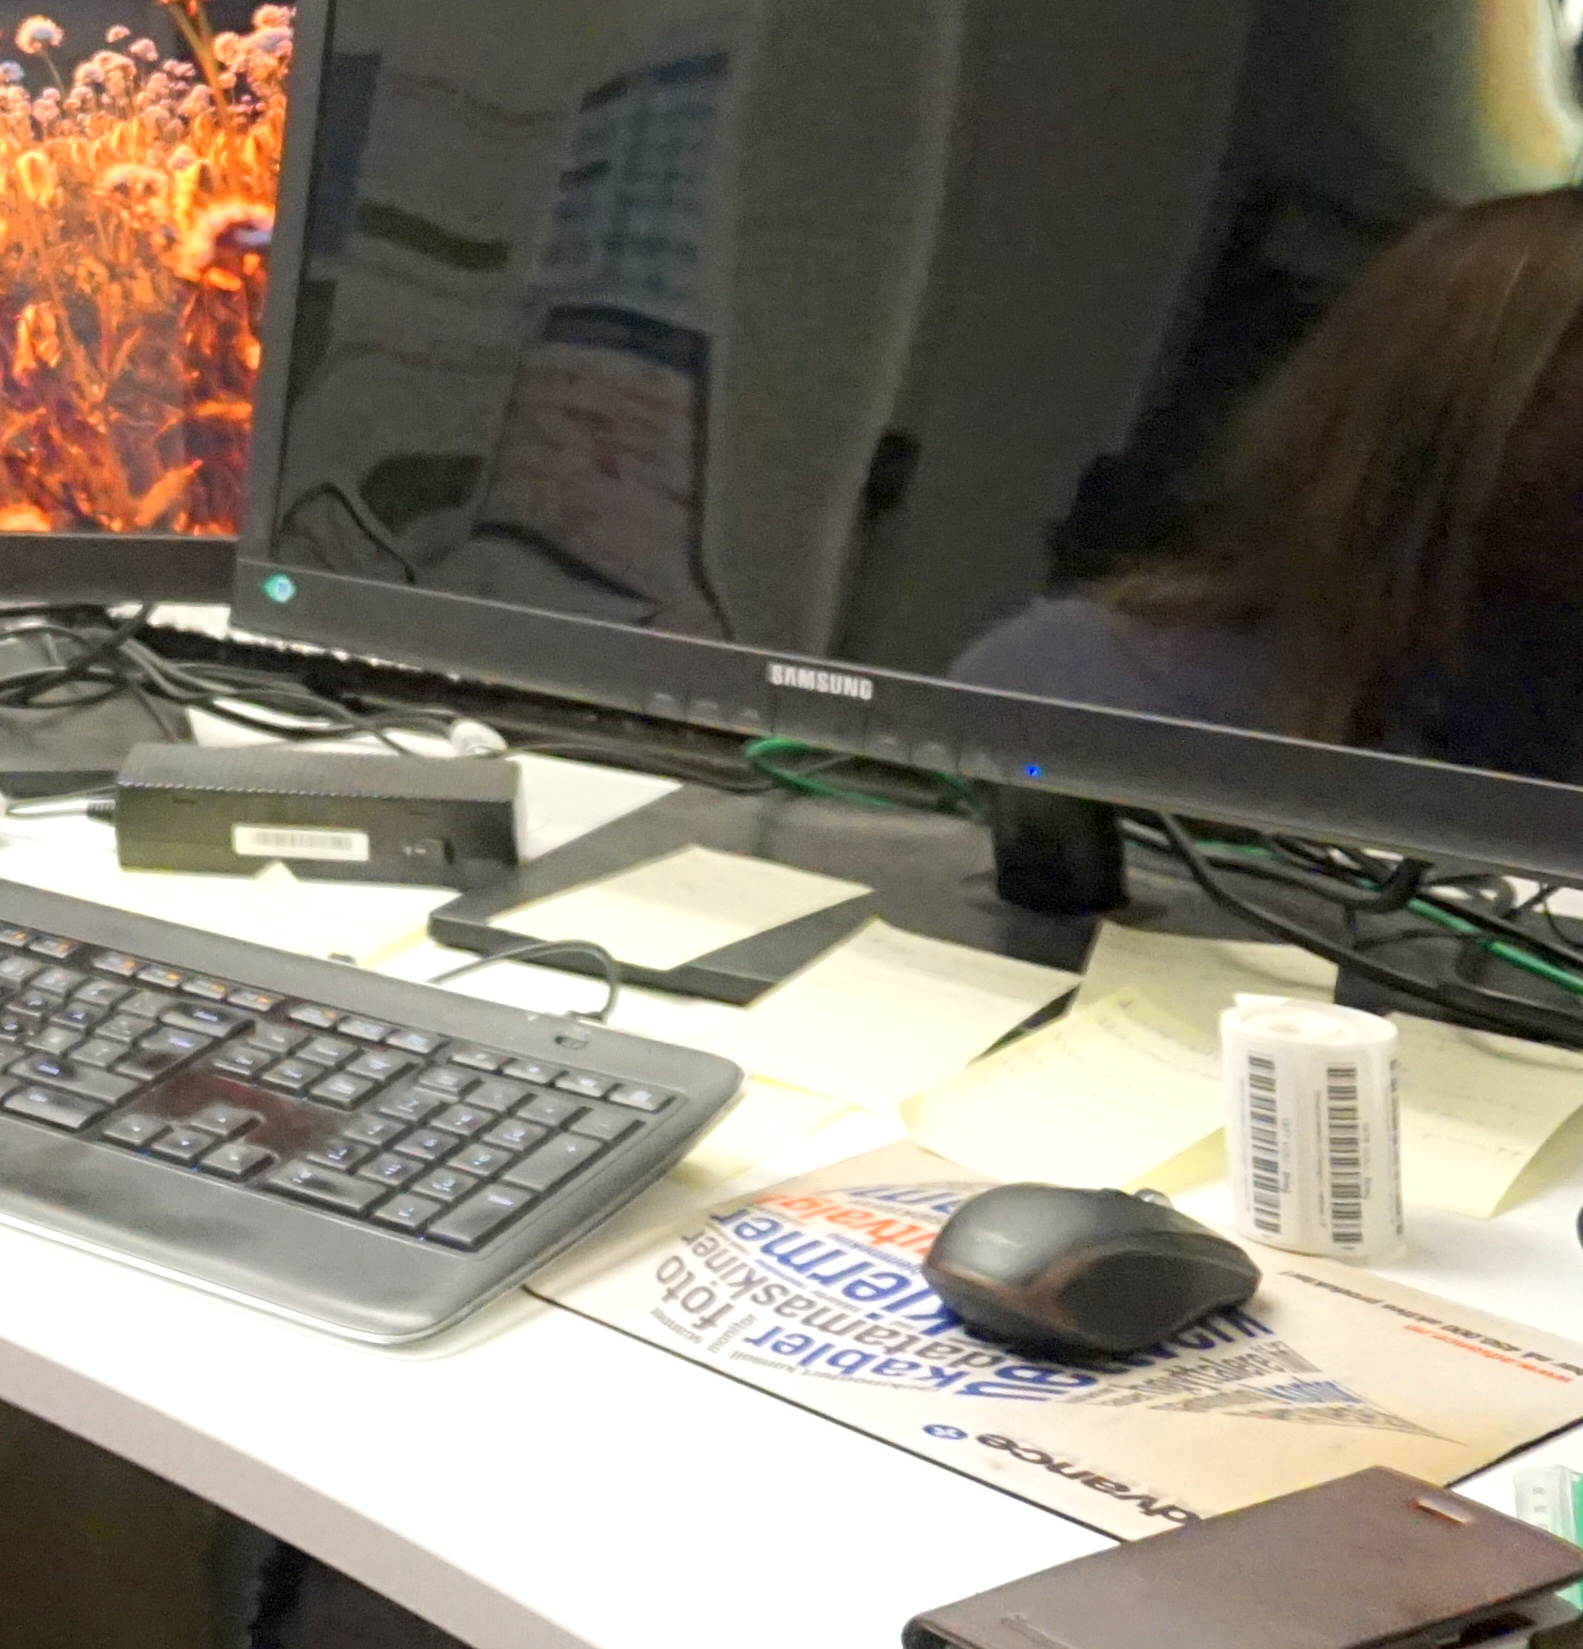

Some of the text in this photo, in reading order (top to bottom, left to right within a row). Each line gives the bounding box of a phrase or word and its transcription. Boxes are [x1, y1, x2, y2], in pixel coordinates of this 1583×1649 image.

[769, 663, 874, 700] SAMSUNG
[650, 1306, 705, 1344] scanner
[655, 1255, 735, 1332] foto
[681, 1229, 1003, 1368] datamaskiner
[707, 1313, 758, 1354] monitor
[743, 1325, 970, 1388] kabler
[976, 1432, 1202, 1524] dvance
